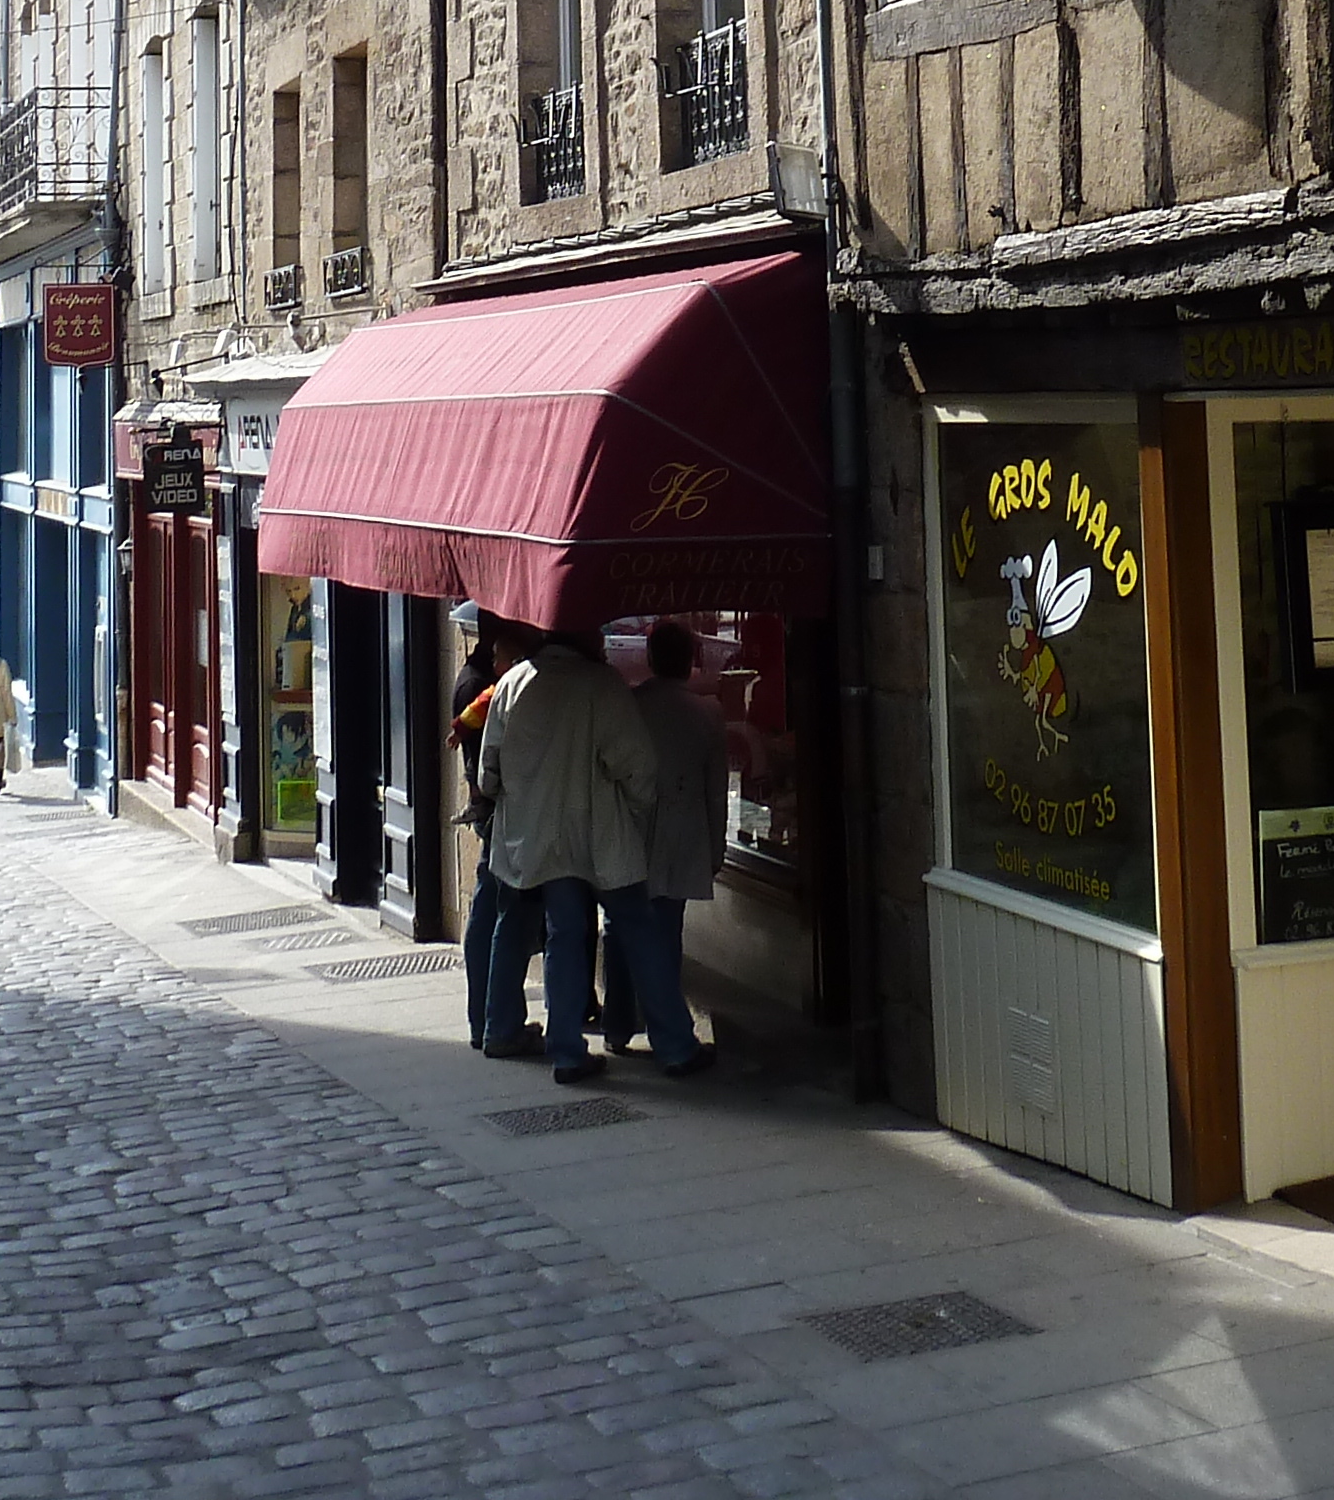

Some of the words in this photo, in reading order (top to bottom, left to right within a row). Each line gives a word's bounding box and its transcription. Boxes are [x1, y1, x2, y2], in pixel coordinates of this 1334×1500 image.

[154, 472, 193, 489] JEUX
[150, 488, 198, 505] VIDEO
[951, 505, 977, 579] LE
[988, 457, 1052, 521] GROS
[1066, 472, 1138, 597] MALO
[609, 548, 806, 579] CORMERAIS
[618, 581, 785, 609] TRAITEUR
[984, 758, 1006, 802] 02
[1010, 783, 1032, 825] 96
[1037, 798, 1059, 834] 87
[1064, 799, 1086, 837] 07
[1091, 784, 1116, 828] 35
[995, 840, 1031, 877] Salle
[1036, 854, 1111, 901] climatisée
